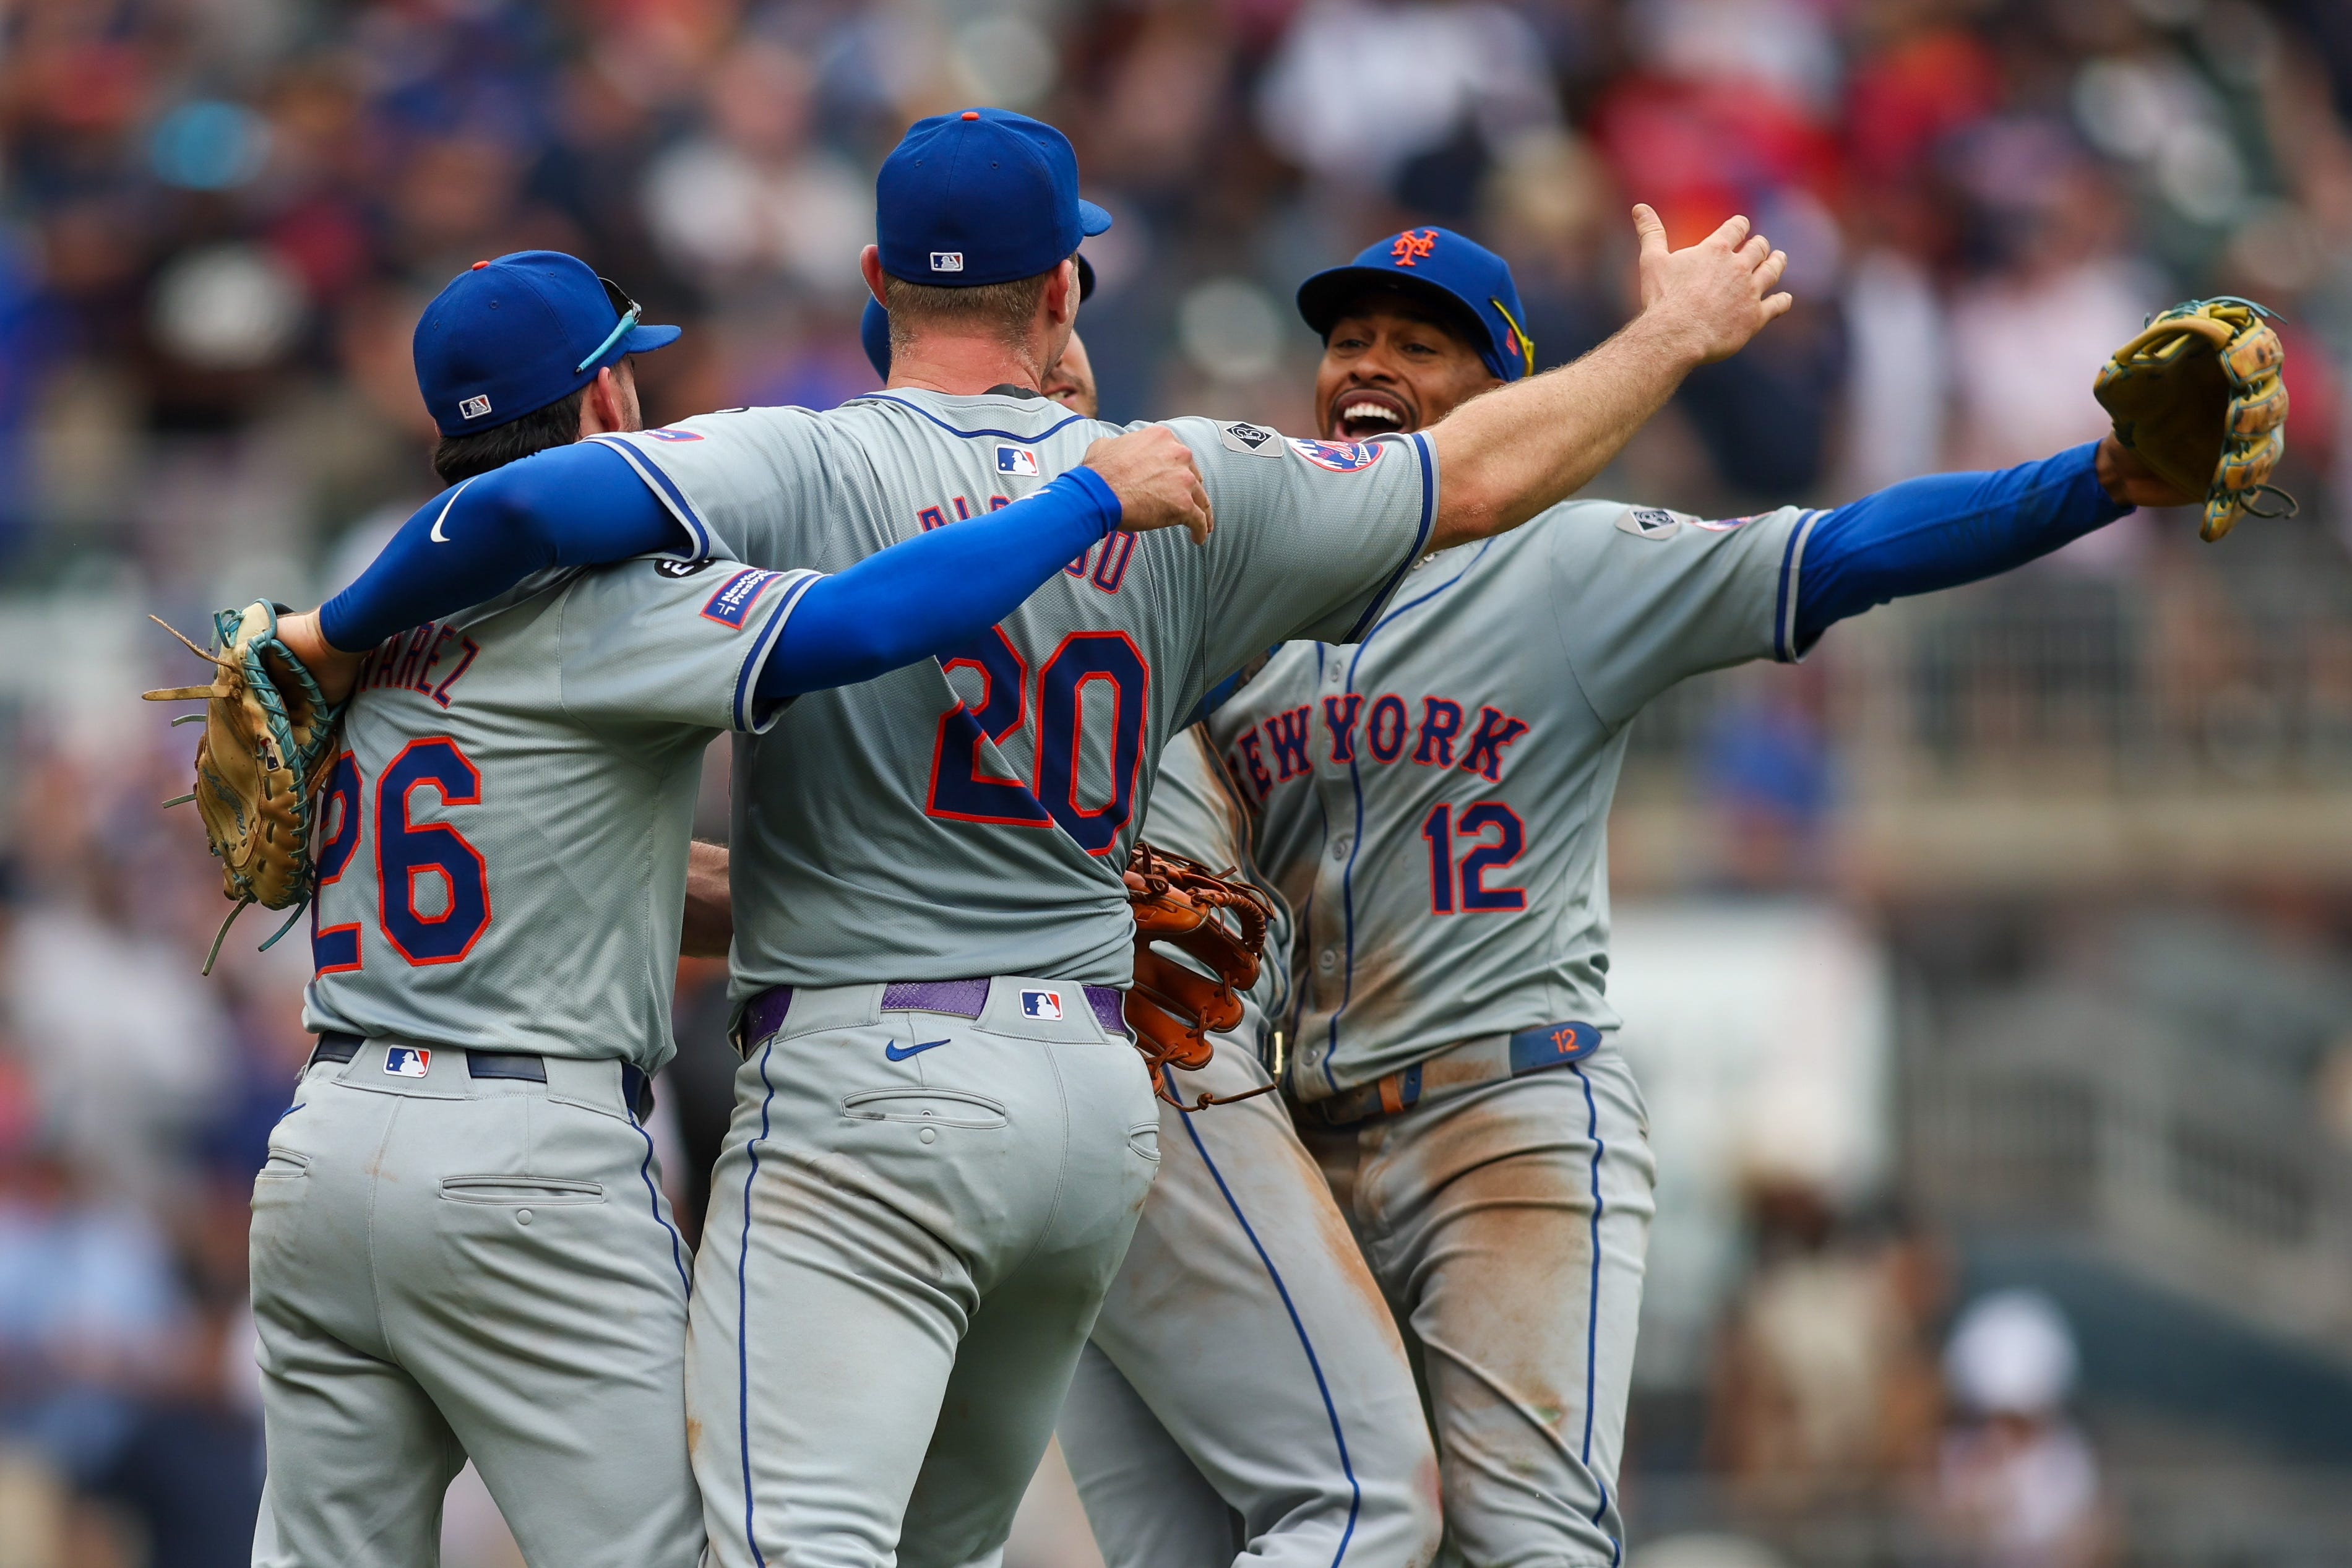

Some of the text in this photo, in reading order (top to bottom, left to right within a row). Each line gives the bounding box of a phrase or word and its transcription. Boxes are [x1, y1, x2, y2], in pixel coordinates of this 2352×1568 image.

[925, 623, 1150, 856] 20
[1322, 693, 1530, 783] YORK
[310, 735, 493, 980] 26
[1423, 800, 1528, 916] 12
[1550, 1028, 1580, 1053] 12
